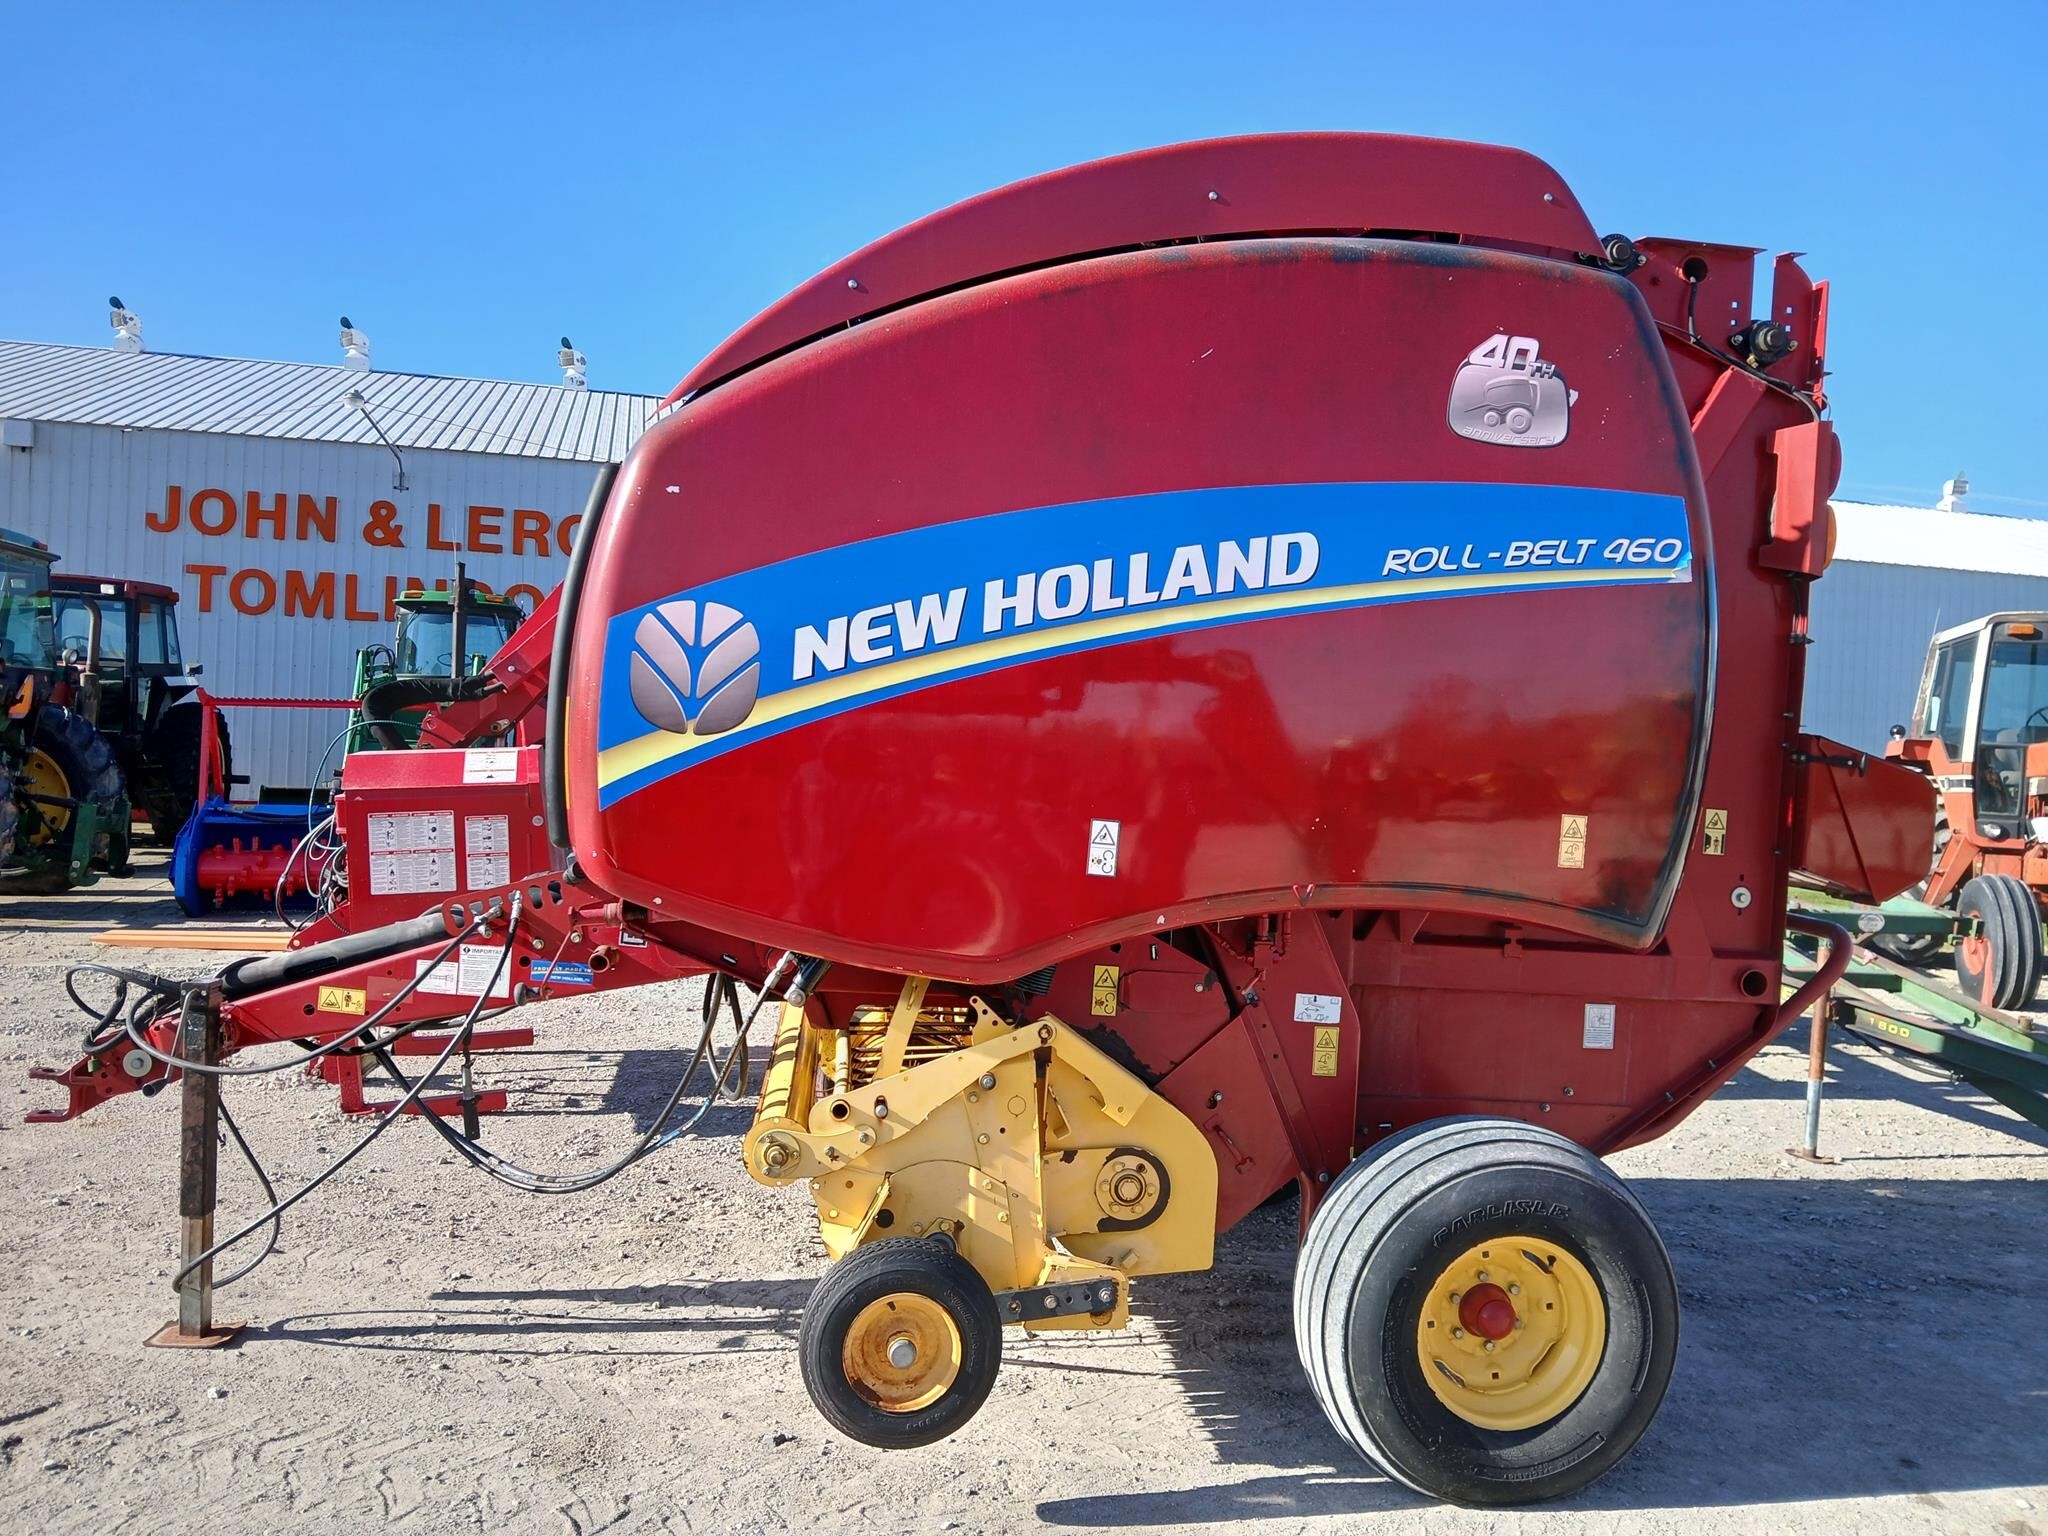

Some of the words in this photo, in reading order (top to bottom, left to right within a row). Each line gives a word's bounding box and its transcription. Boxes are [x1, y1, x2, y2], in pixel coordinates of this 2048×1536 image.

[145, 486, 338, 543] JOHN
[362, 500, 406, 549] &
[1382, 539, 1598, 577] ROLL-BELT
[1603, 538, 1683, 564] 460
[792, 588, 967, 681] NEW
[983, 532, 1320, 633] HOLLAND
[1433, 1199, 1570, 1248] CARLISLE
